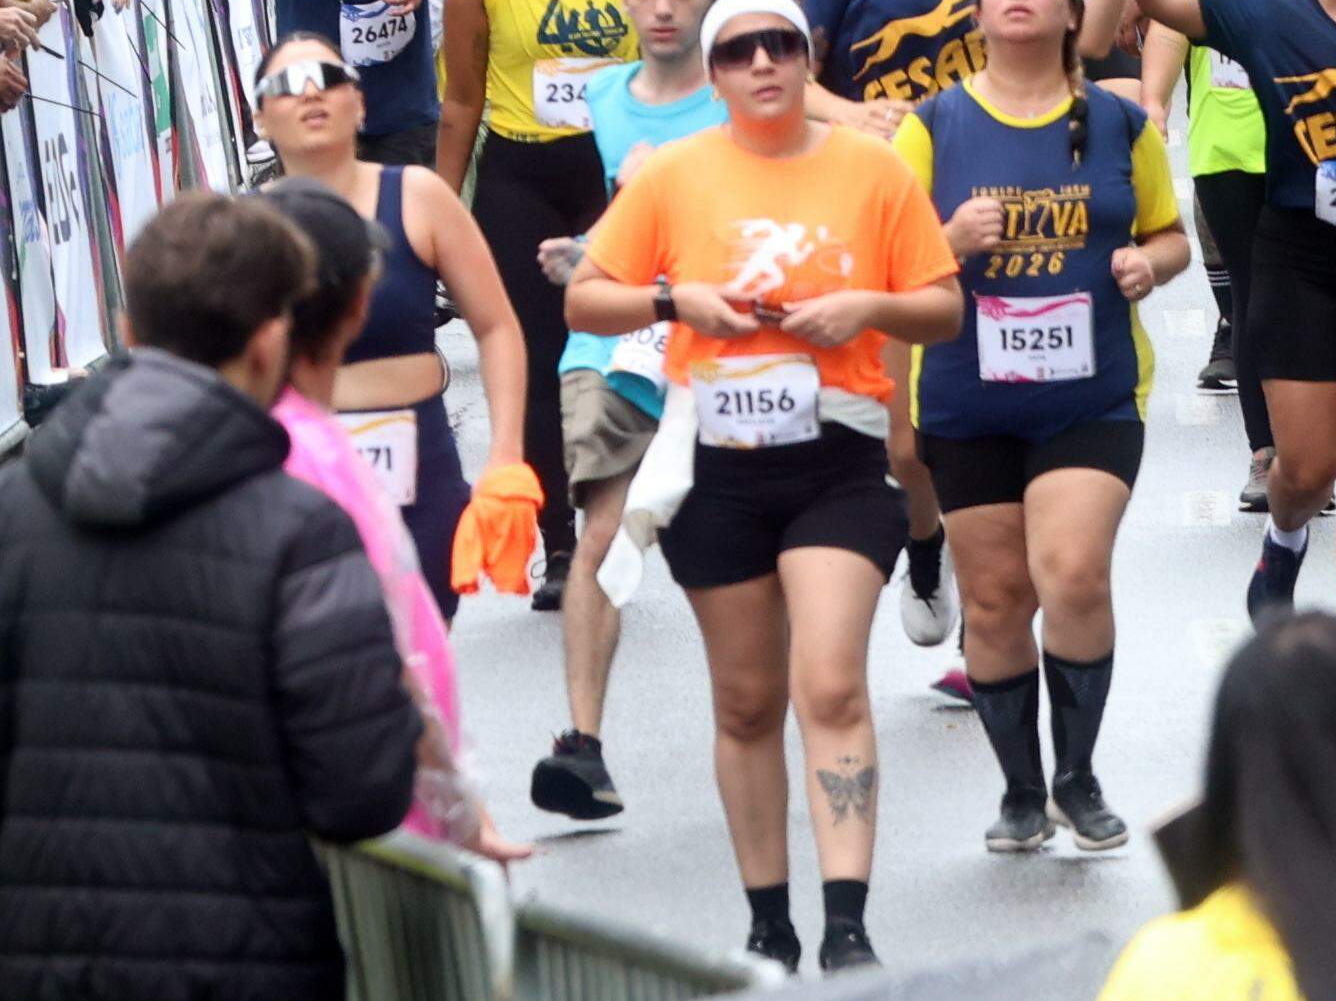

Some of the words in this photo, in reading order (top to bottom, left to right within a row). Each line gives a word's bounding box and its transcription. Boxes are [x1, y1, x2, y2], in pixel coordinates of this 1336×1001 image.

[351, 14, 408, 45] 26474
[984, 251, 1065, 279] 2026
[1000, 324, 1073, 351] 15251
[714, 386, 796, 416] 21156
